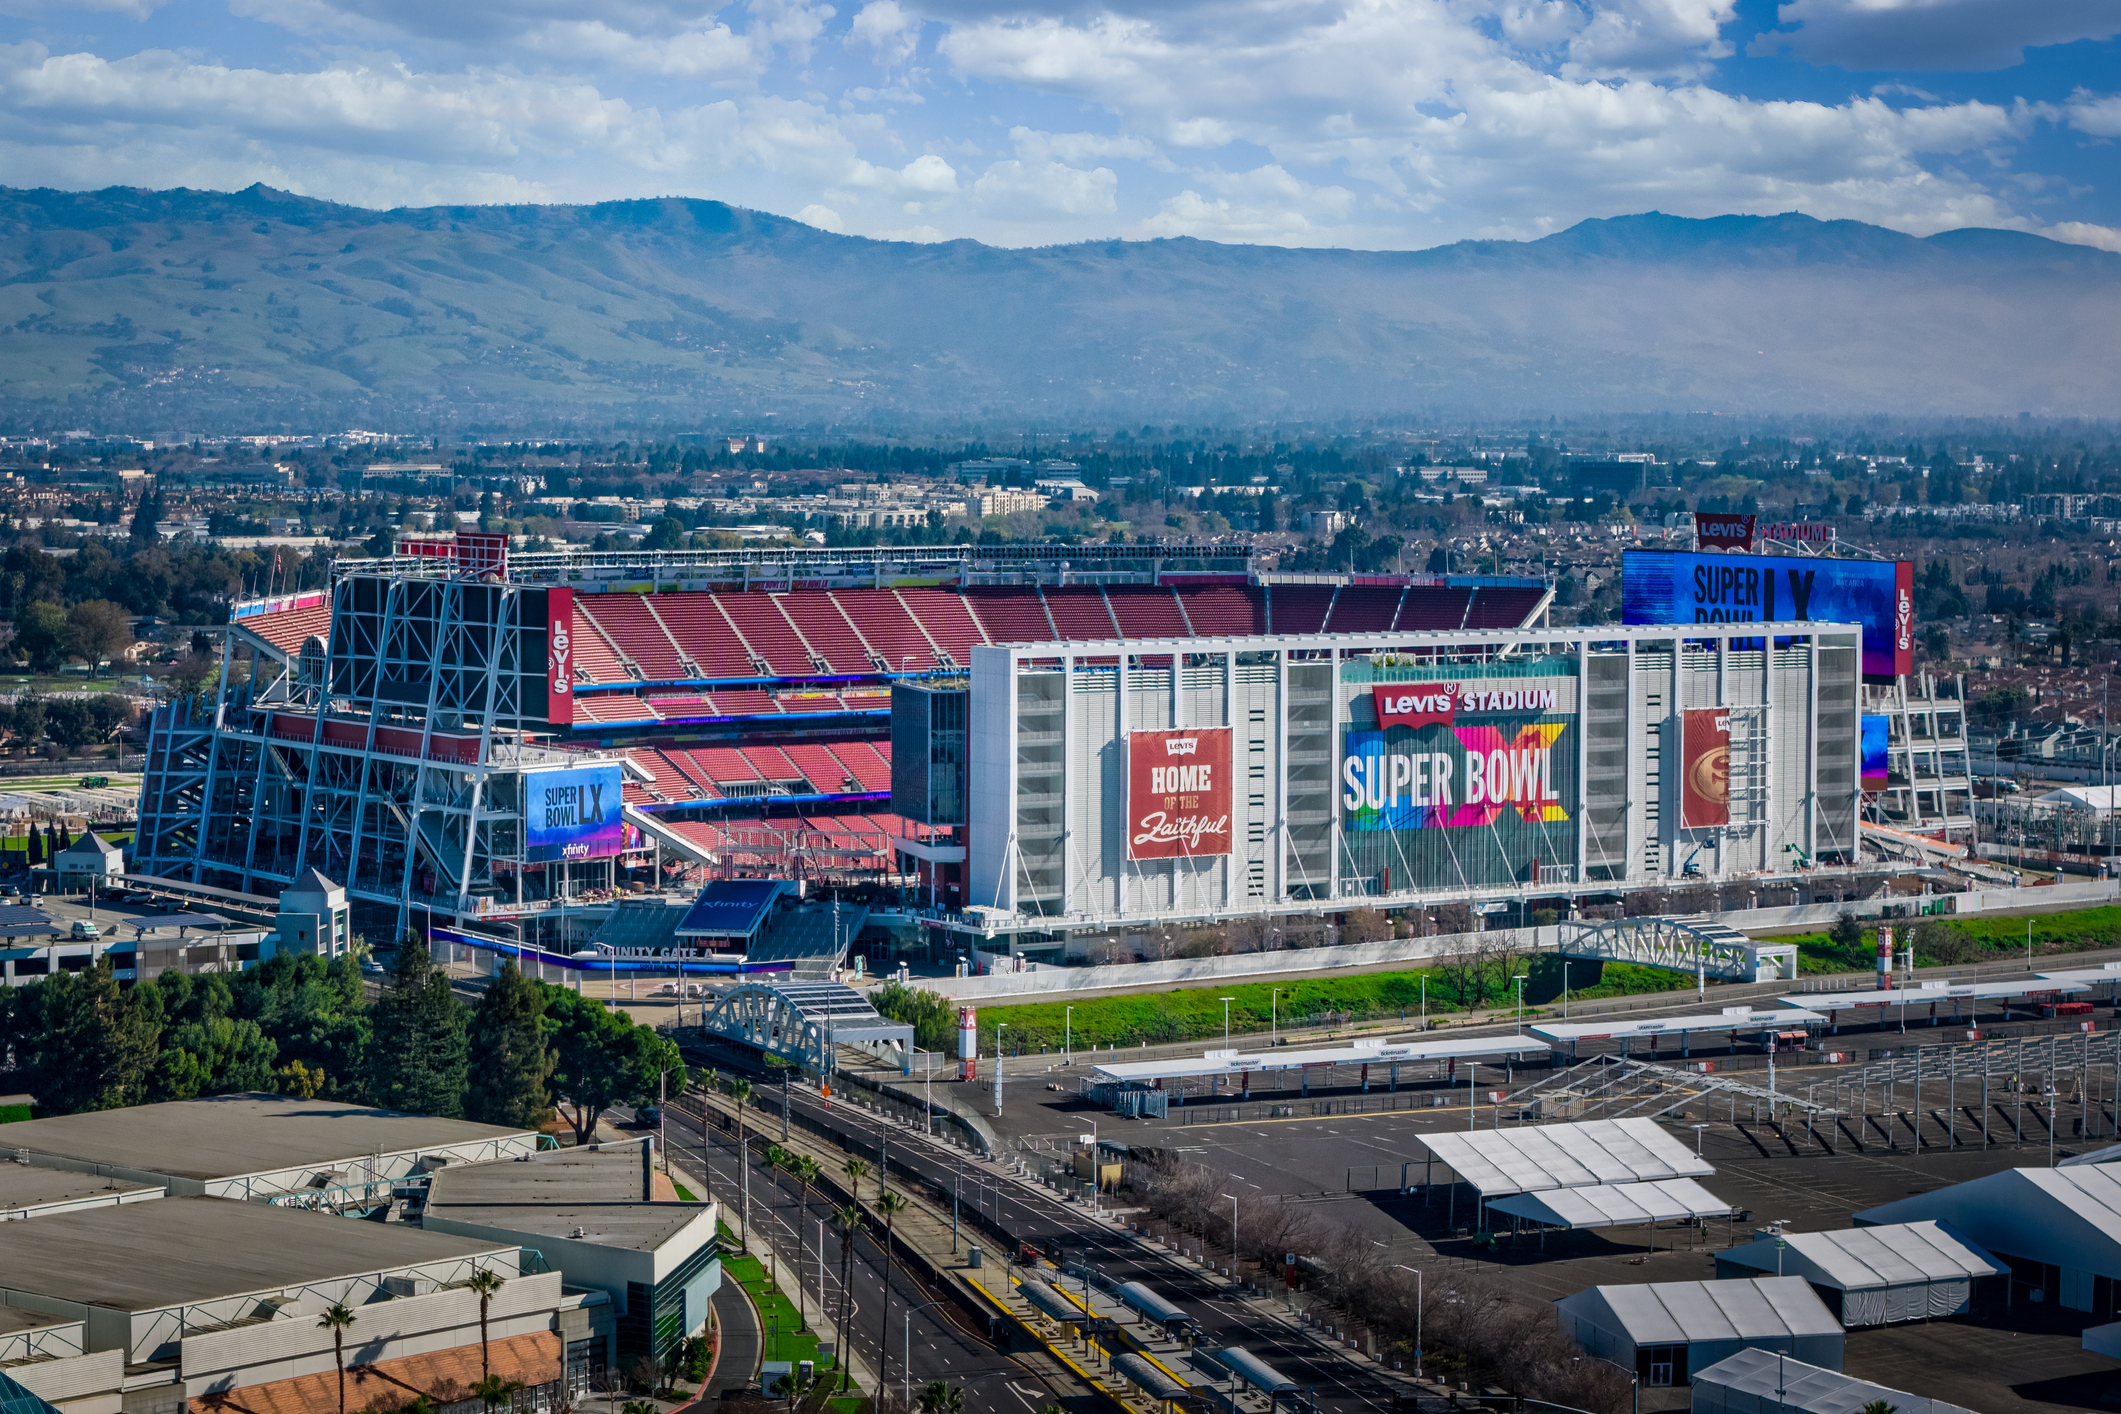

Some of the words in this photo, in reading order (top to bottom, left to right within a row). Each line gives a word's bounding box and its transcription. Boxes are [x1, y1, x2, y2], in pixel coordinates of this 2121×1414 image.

[1757, 523, 1827, 542] STADIUM
[1694, 565, 1759, 607] SUPER
[1463, 689, 1557, 712] STADIUM
[1151, 764, 1212, 794] HOME
[1343, 752, 1453, 811] SUPER
[1465, 748, 1559, 804] BOWL
[545, 786, 577, 806] SUPER
[578, 784, 604, 825] LX
[1164, 796, 1176, 810] OF
[1179, 796, 1199, 810] THE
[546, 806, 578, 828] BOWL
[1133, 811, 1228, 849] Faithful
[562, 843, 590, 858] xfinity
[702, 900, 758, 908] xfinity
[1886, 934, 1892, 945] B
[660, 948, 698, 958] GATE
[704, 948, 713, 959] A
[966, 1014, 976, 1027] A
